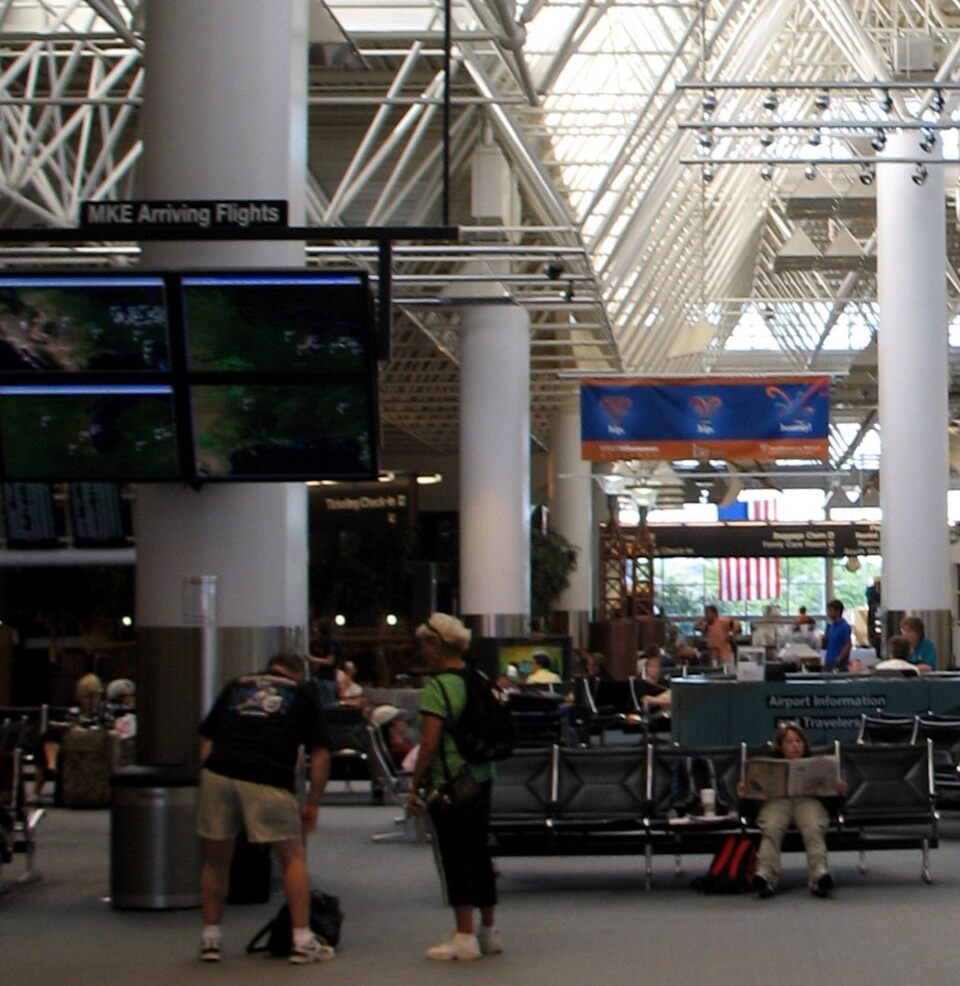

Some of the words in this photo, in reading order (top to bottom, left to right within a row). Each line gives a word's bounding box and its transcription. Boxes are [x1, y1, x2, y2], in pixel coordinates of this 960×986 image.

[88, 204, 133, 223] MKE
[138, 203, 210, 227] Arriving
[215, 202, 280, 226] Flights
[768, 695, 810, 708] Airport
[814, 695, 886, 707] Information
